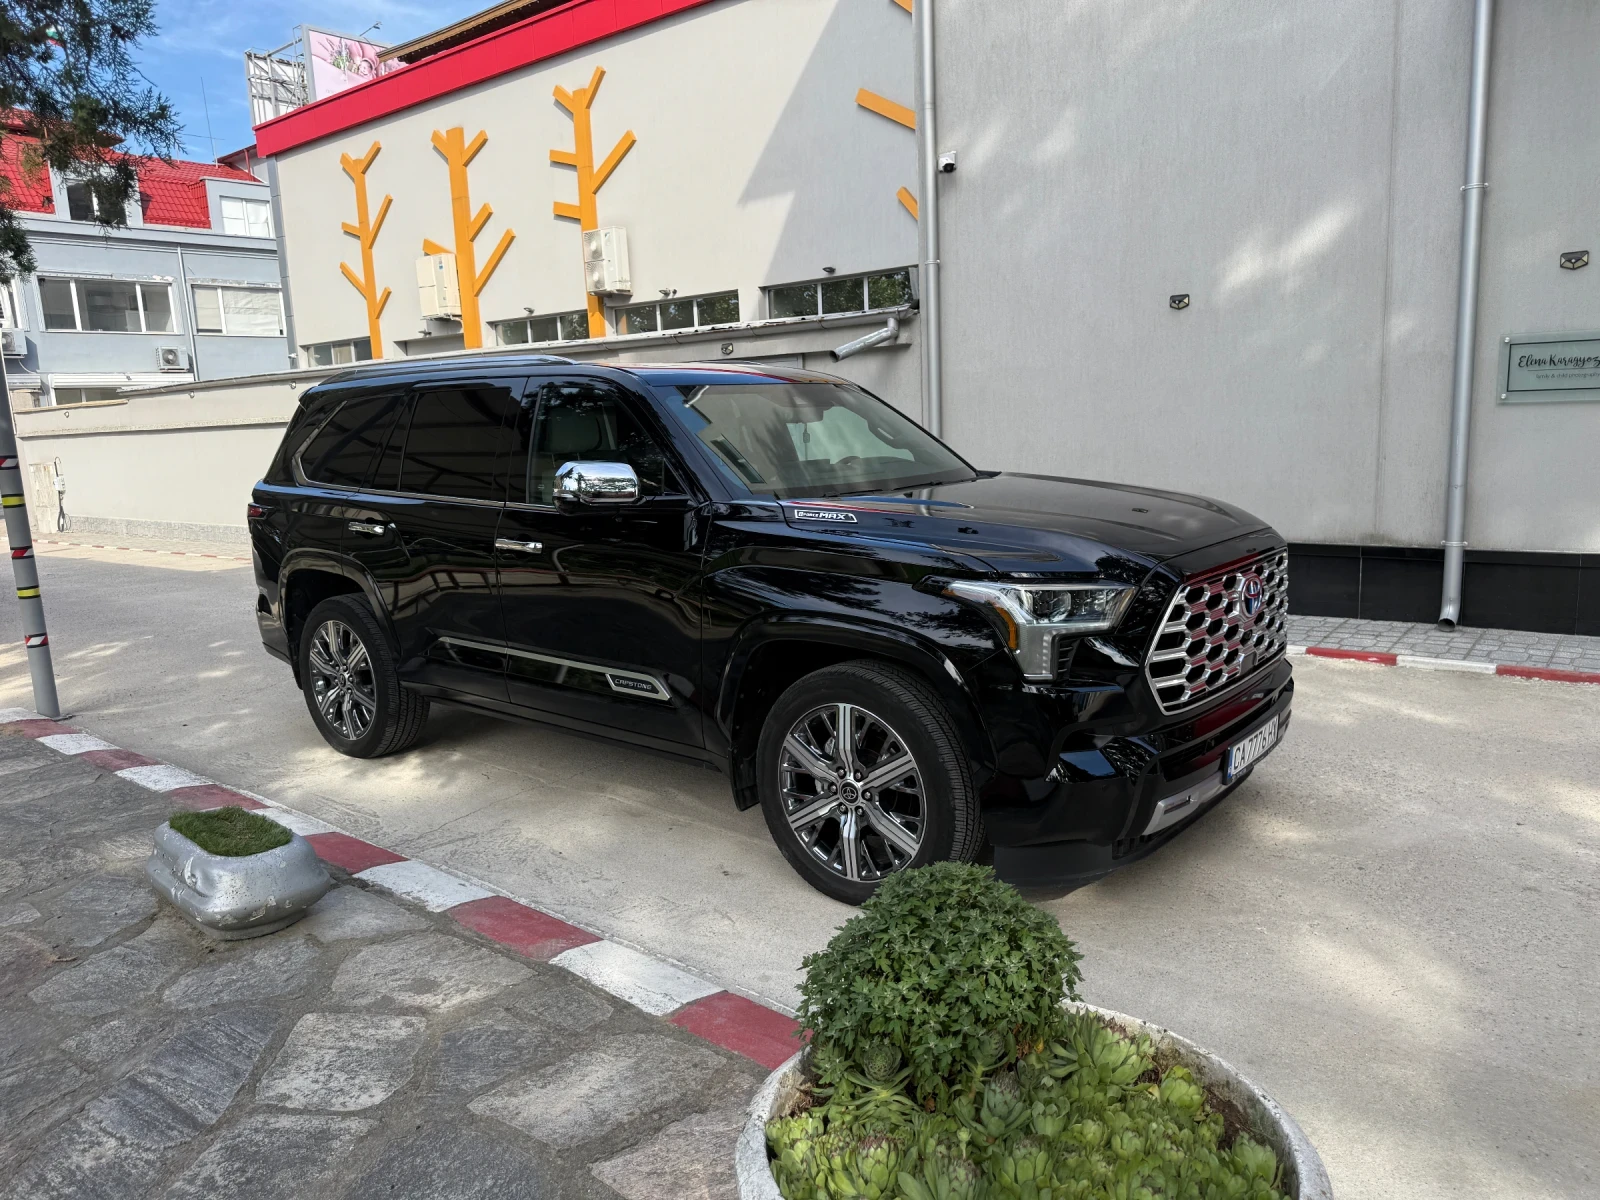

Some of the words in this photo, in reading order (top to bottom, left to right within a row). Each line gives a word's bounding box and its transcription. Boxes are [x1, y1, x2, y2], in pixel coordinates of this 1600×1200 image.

[1518, 354, 1548, 368] Elena
[819, 512, 846, 520] MAX
[614, 679, 652, 690] CAPSTONE
[1233, 742, 1246, 771] CA
[1247, 726, 1267, 762] 7776
